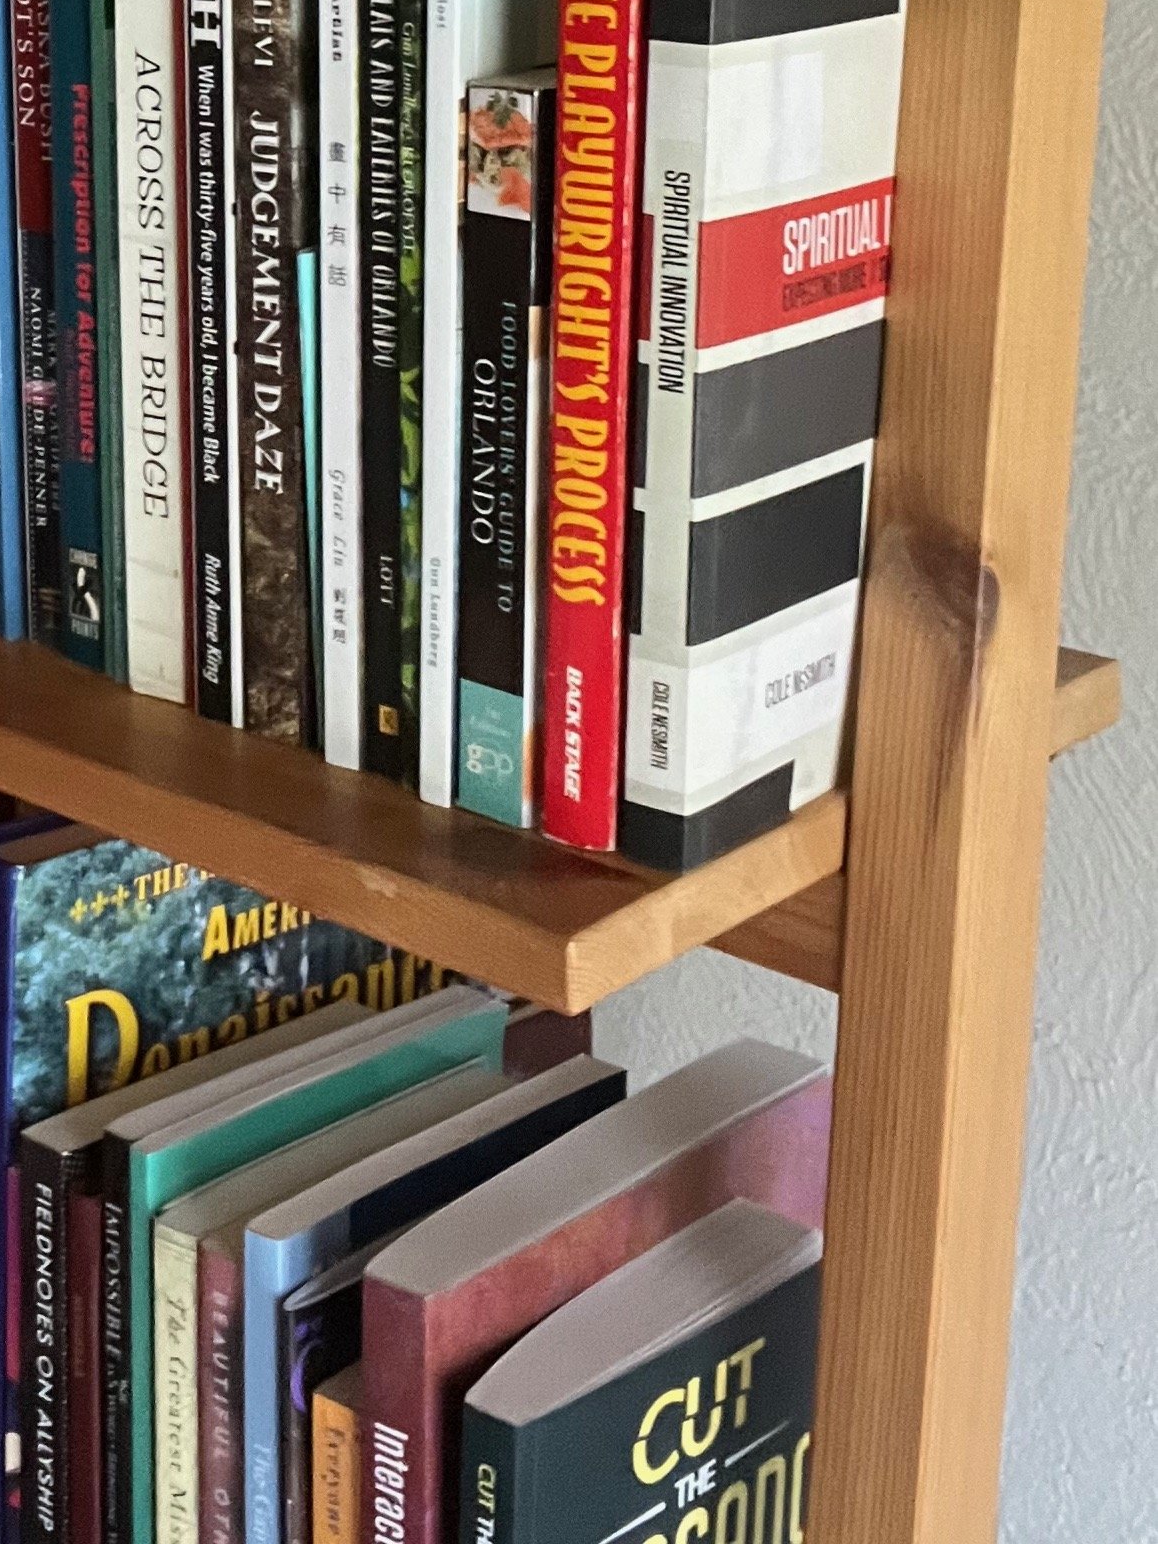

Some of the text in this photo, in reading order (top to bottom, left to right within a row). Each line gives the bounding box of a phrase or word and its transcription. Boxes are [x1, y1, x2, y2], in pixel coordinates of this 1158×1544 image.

[252, 0, 275, 67] LEVI
[370, 59, 396, 108] AND
[400, 21, 417, 57] Gun
[17, 63, 35, 129] SON
[70, 82, 95, 303] Prescription for
[370, 116, 396, 221] EATERIES
[553, 40, 618, 405] PLAYWRIGHT'S
[133, 48, 170, 520] ACROSS THE BRIDGE
[195, 65, 222, 483] When I was thirty-five years old, I became Black
[371, 230, 396, 255] OF
[656, 170, 691, 394] SPIRITUAL INNOVATION
[783, 199, 881, 275] SPIRITUAL
[29, 286, 44, 362] NAOMI
[249, 109, 286, 496] JUDGEMENT DAZE
[371, 263, 399, 368] ORLANDO
[470, 357, 497, 546] ORLANDO
[496, 301, 518, 614] FOOD LOVERS' GUIDE TO
[550, 413, 611, 607] PROCESS
[329, 469, 347, 567] Grace Lin
[201, 553, 224, 684] Ruth Anne King
[378, 555, 395, 610] LOTT
[426, 556, 442, 669] Gun Lundberg
[562, 665, 583, 803] BACK STAGE
[652, 680, 670, 714] COLE
[134, 863, 188, 900] THE
[104, 1202, 123, 1361] IMPOSSIBLE
[35, 1183, 55, 1532] FIELDNOTES ON ALLYSHIP
[165, 1296, 188, 1473] The Greatest
[211, 1290, 230, 1462] BEAUTIFUL
[632, 1337, 766, 1484] CUT
[477, 1463, 497, 1513] CUT
[673, 1458, 717, 1508] THE
